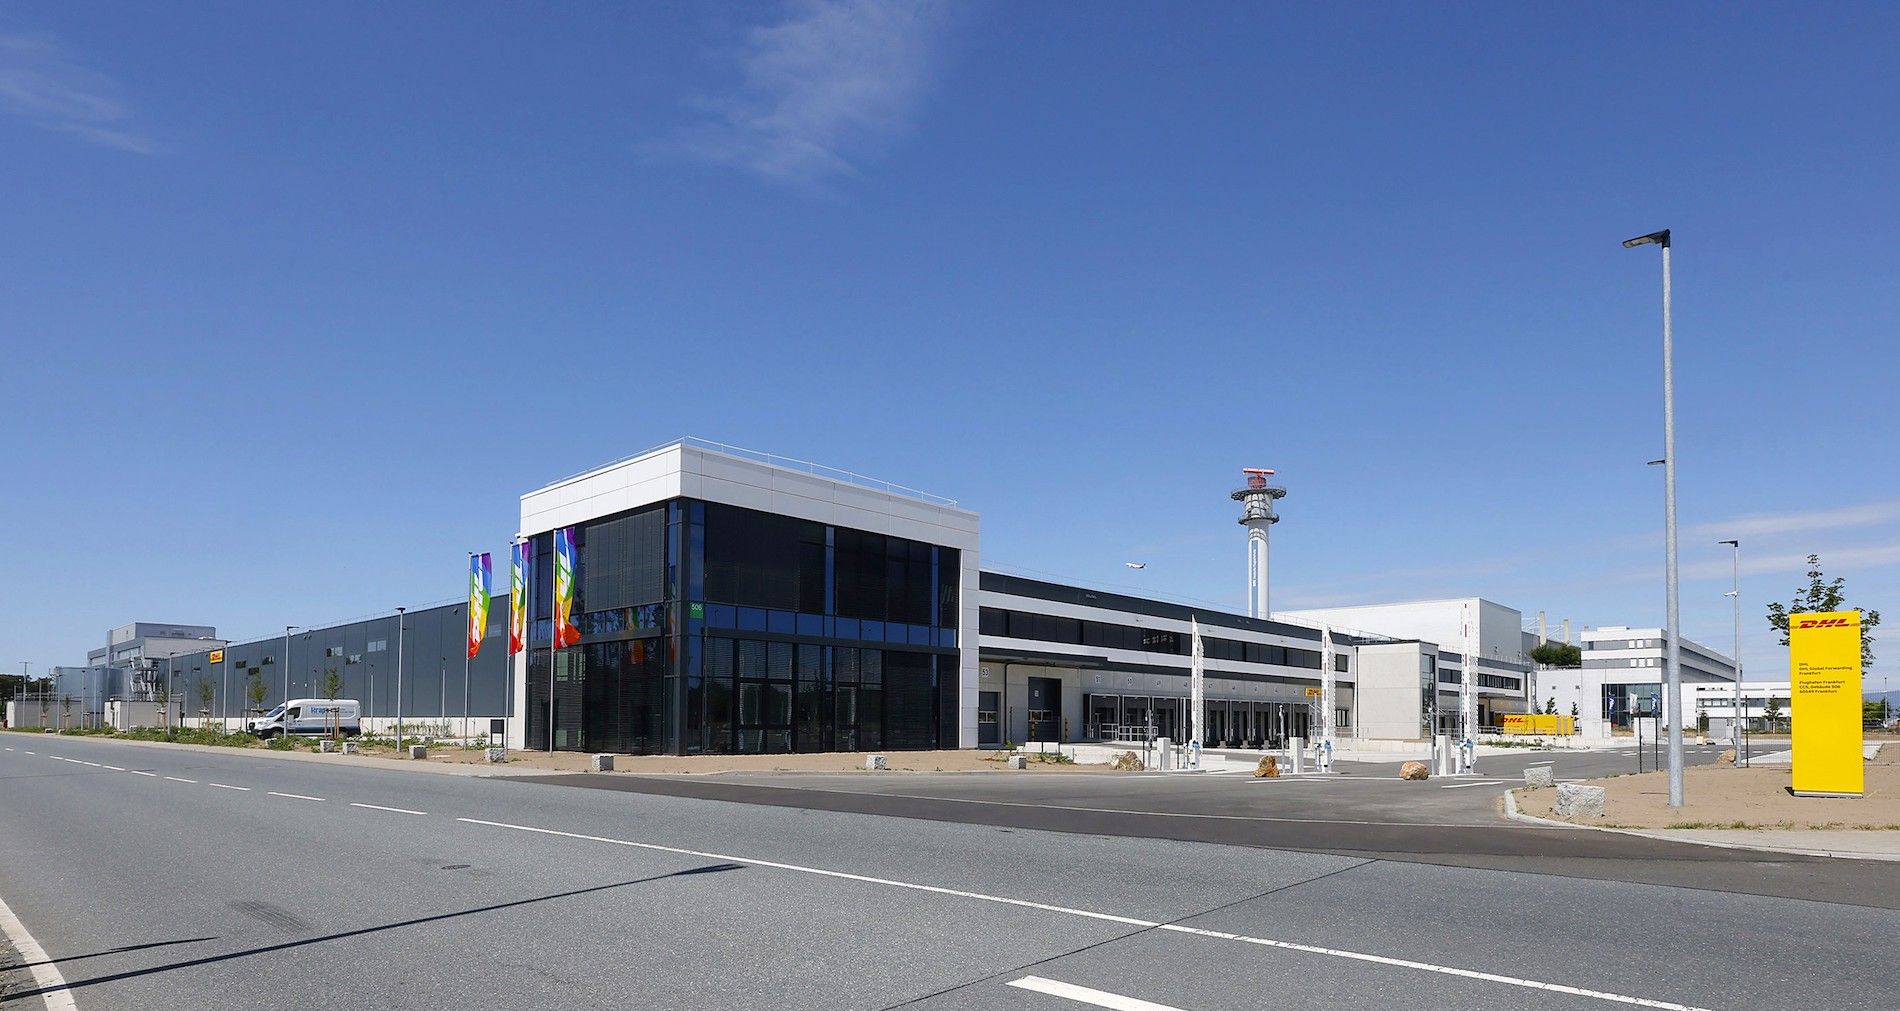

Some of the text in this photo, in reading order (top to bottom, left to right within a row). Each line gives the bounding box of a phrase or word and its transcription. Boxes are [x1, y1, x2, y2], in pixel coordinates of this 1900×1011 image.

[691, 603, 703, 611] 506
[1799, 618, 1850, 629] DHL
[982, 668, 989, 676] 53
